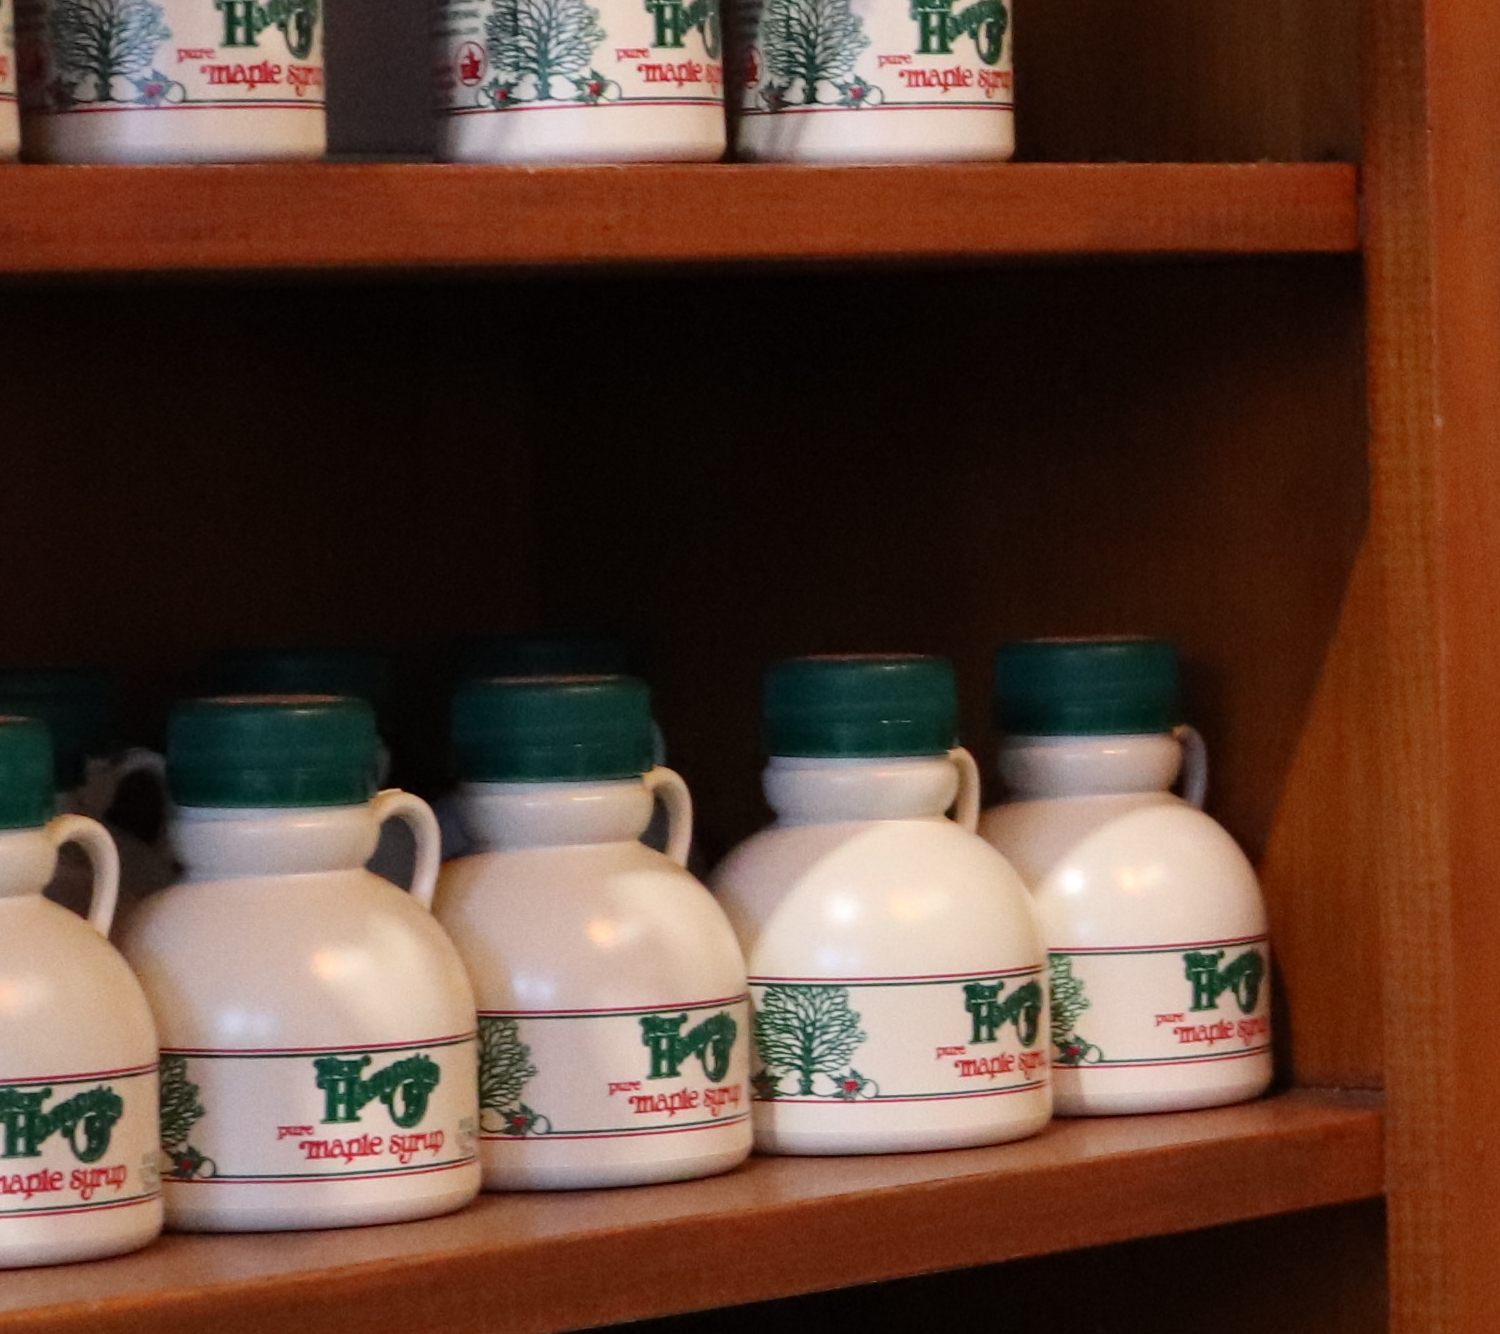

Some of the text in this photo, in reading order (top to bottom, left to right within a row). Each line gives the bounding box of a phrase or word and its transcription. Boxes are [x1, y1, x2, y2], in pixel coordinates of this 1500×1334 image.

[177, 48, 216, 63] pure
[615, 48, 650, 62] pure
[878, 54, 913, 68] pure
[200, 59, 282, 92] maple
[636, 59, 703, 89] maple
[899, 65, 974, 94] maple
[1173, 1019, 1234, 1047] maple
[953, 1051, 1015, 1079] maple
[608, 1080, 642, 1096] pure
[628, 1086, 699, 1117] maple
[276, 1125, 315, 1141] pure
[298, 1133, 384, 1165] maple
[389, 1130, 445, 1164] syrup
[69, 1165, 127, 1201] syrup
